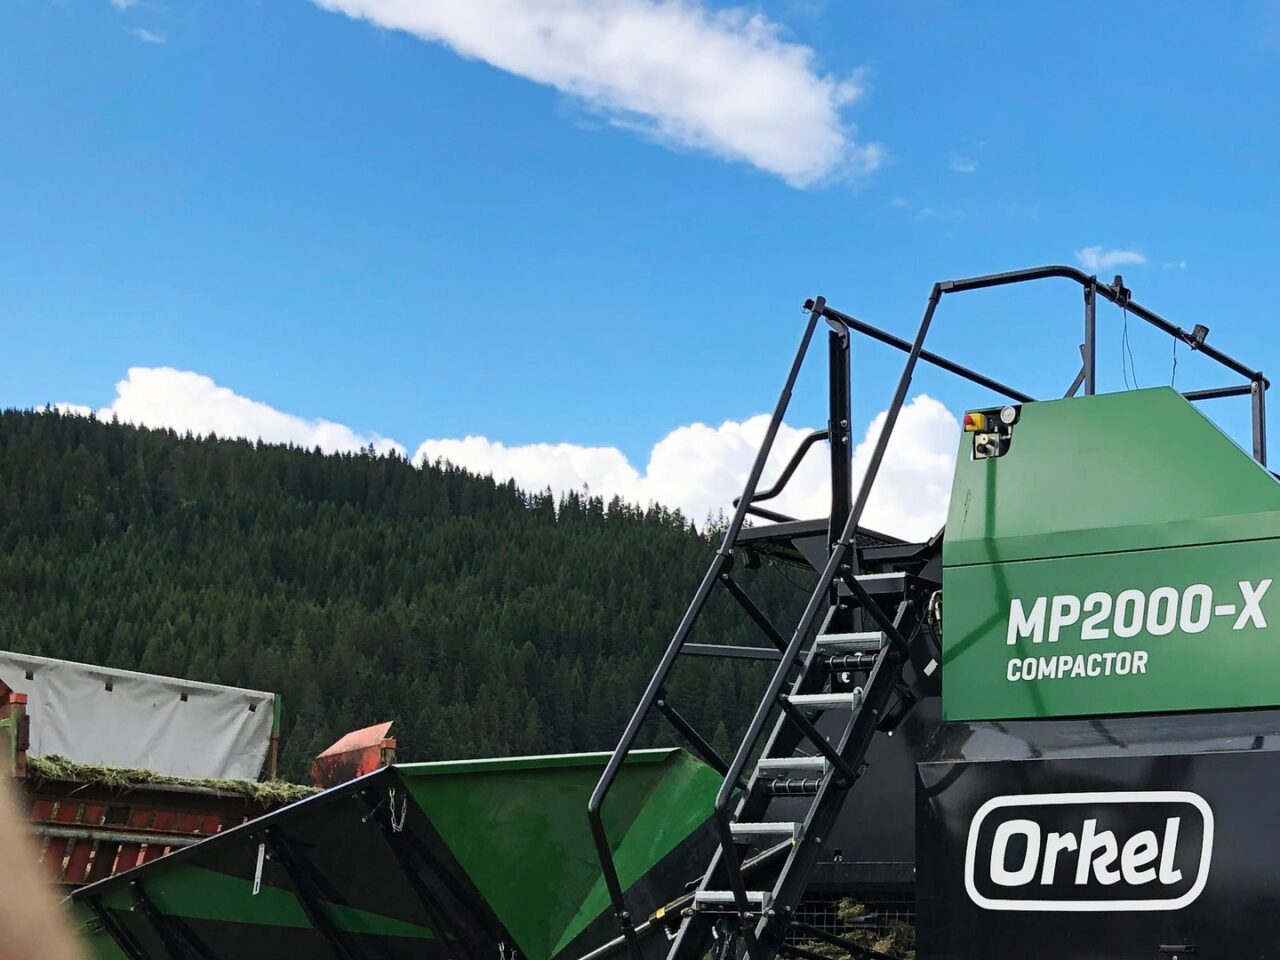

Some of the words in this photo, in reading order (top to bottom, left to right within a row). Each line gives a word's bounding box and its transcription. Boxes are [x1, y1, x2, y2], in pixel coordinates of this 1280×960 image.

[1007, 579, 1272, 645] MP2000-X
[1007, 651, 1149, 682] COMPACTOR
[990, 816, 1183, 887] Orkel
